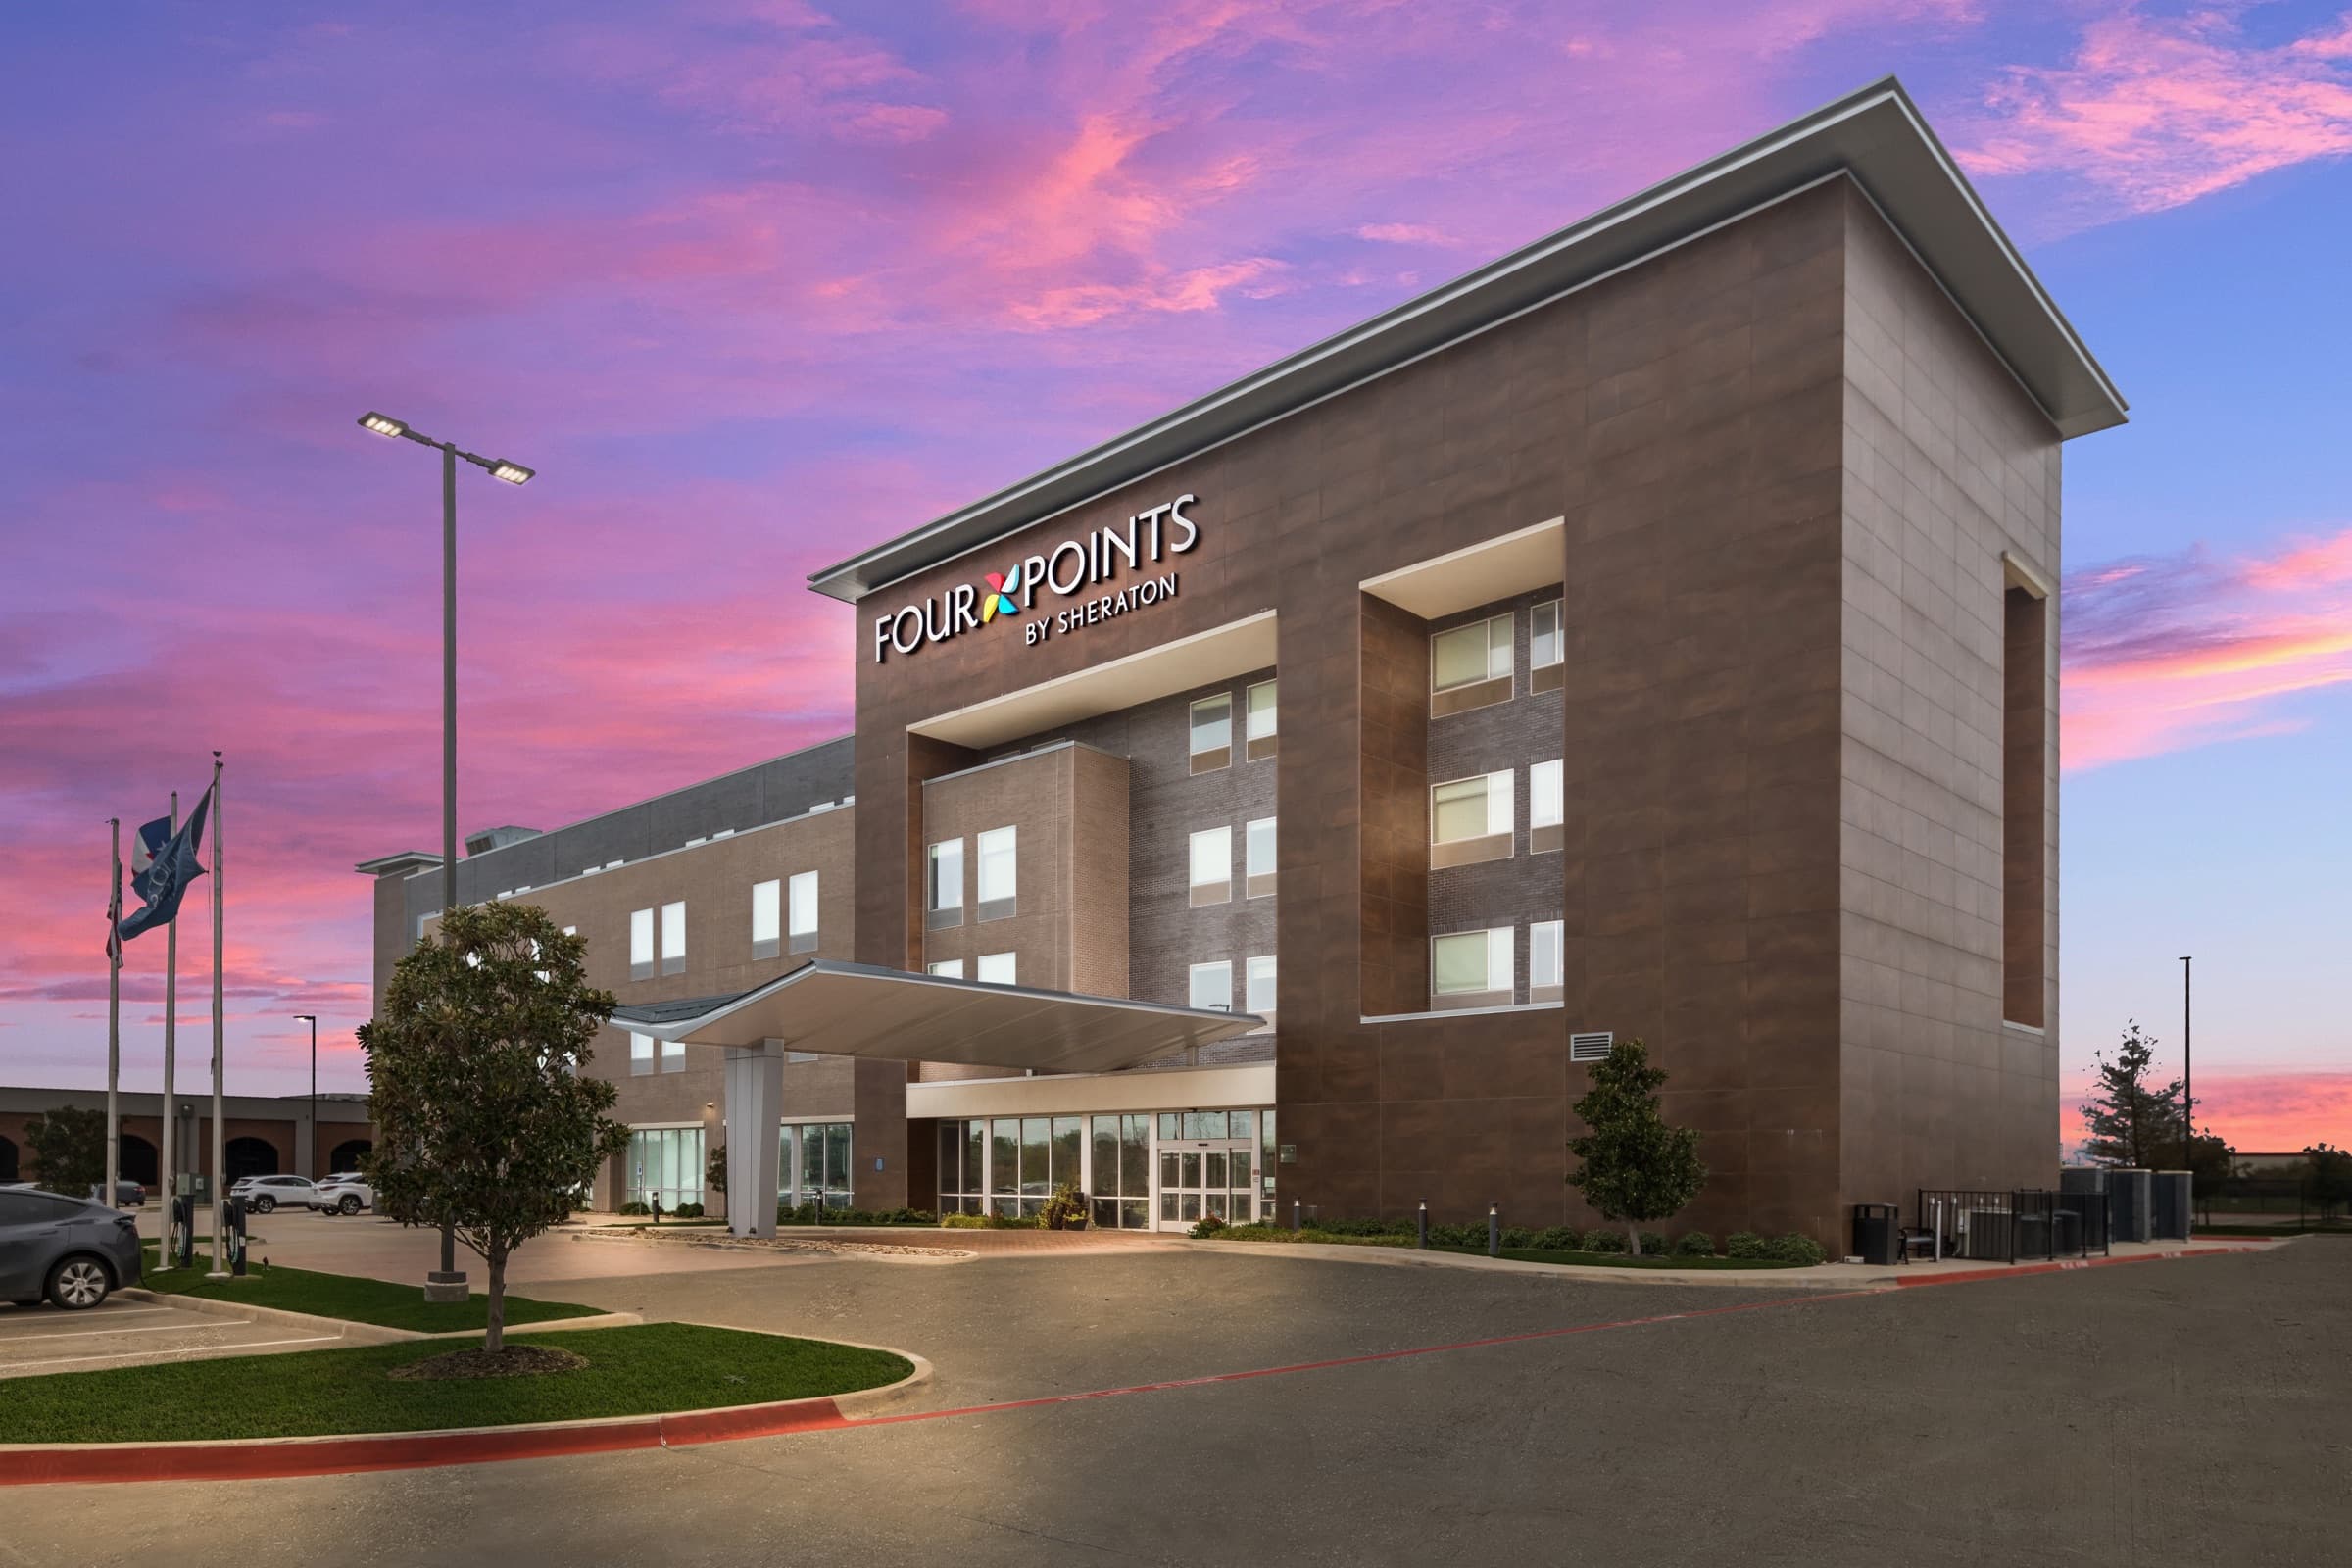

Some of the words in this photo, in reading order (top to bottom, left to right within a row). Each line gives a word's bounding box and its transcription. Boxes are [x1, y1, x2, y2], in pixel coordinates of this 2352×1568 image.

[875, 584, 978, 663] FOUR
[1024, 494, 1198, 607] POINTS
[1025, 617, 1051, 645] BY
[1058, 573, 1177, 634] SHERATON
